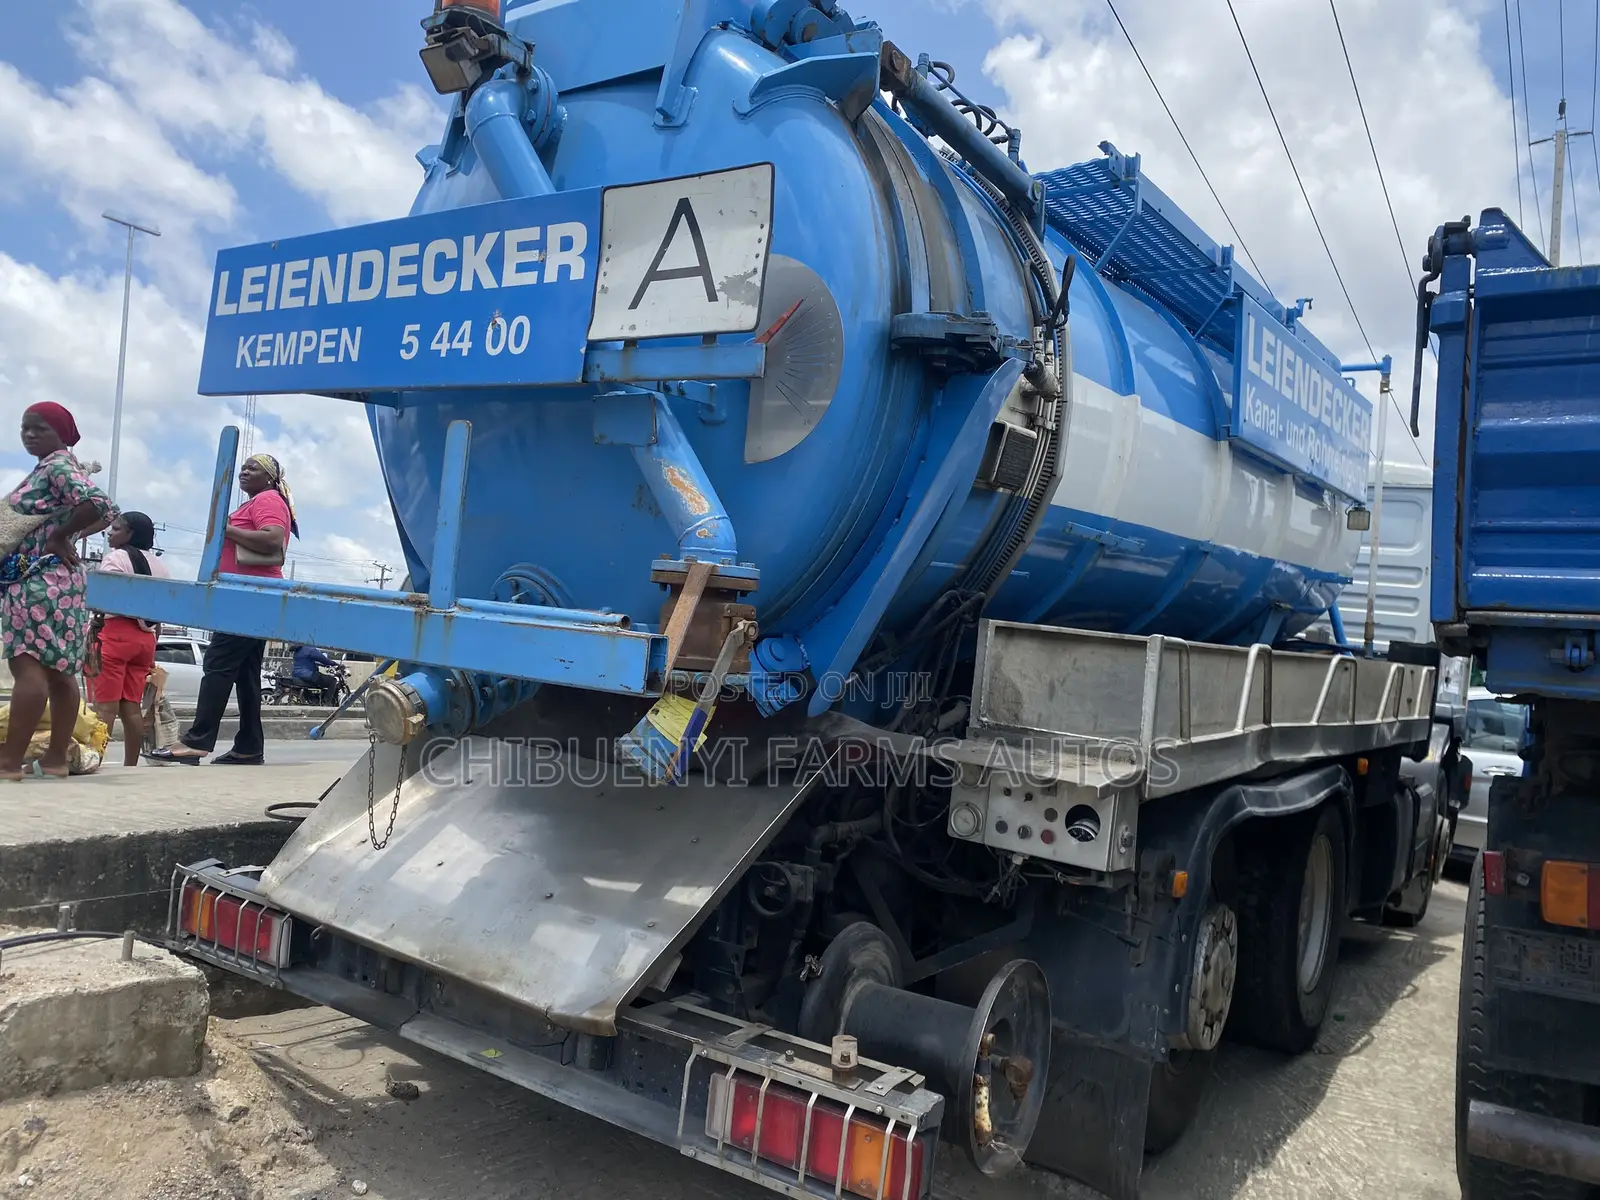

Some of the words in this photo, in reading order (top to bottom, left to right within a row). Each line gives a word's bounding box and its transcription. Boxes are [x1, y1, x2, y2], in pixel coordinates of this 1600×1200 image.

[215, 221, 588, 317] LEIENDECKER
[628, 197, 719, 310] A
[235, 326, 362, 369] KEMPEN
[399, 323, 420, 361] 5
[430, 320, 474, 358] 44
[485, 314, 531, 355] 00
[1247, 315, 1370, 446] LEIENDECKER
[1246, 382, 1283, 438] Kanal-
[1285, 418, 1305, 453] und
